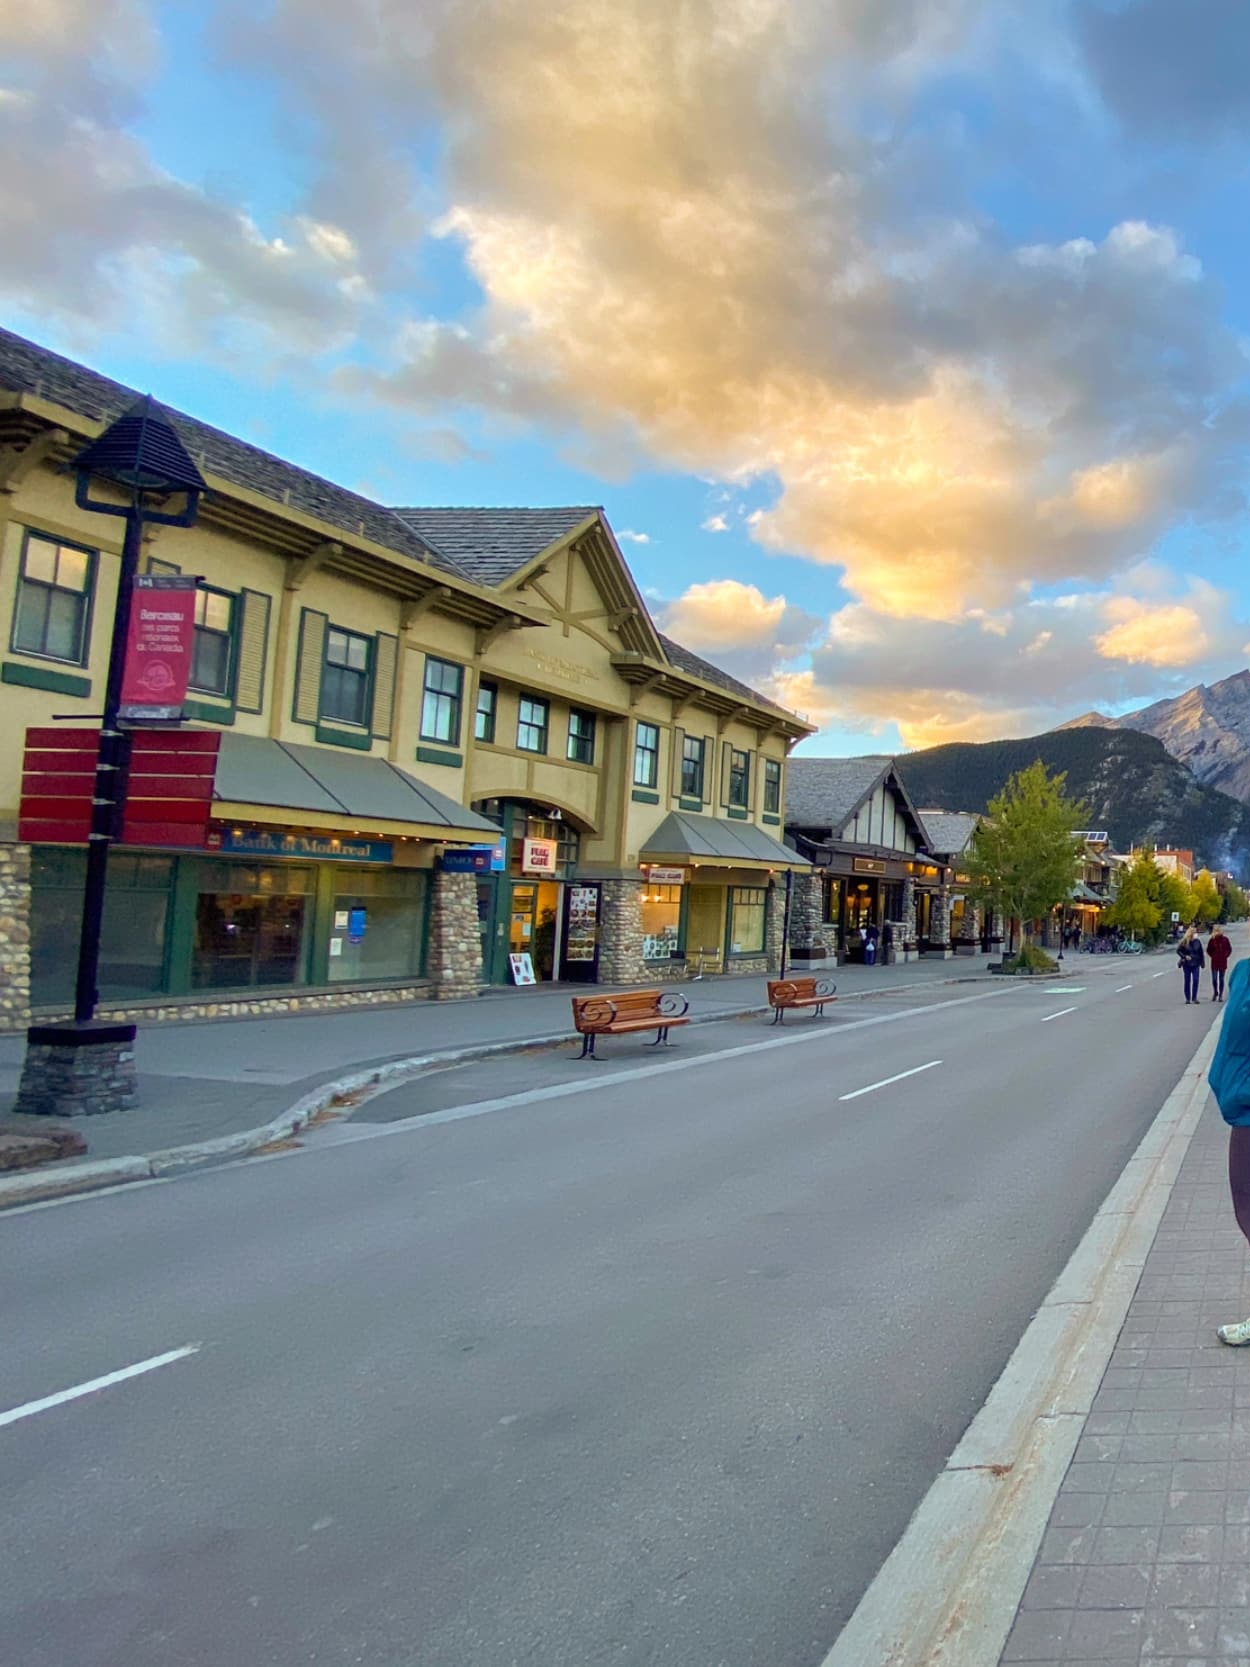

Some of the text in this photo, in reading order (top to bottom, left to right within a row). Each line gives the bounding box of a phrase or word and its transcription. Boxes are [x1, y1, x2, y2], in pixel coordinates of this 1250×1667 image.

[231, 833, 370, 857] Bank of Montreal
